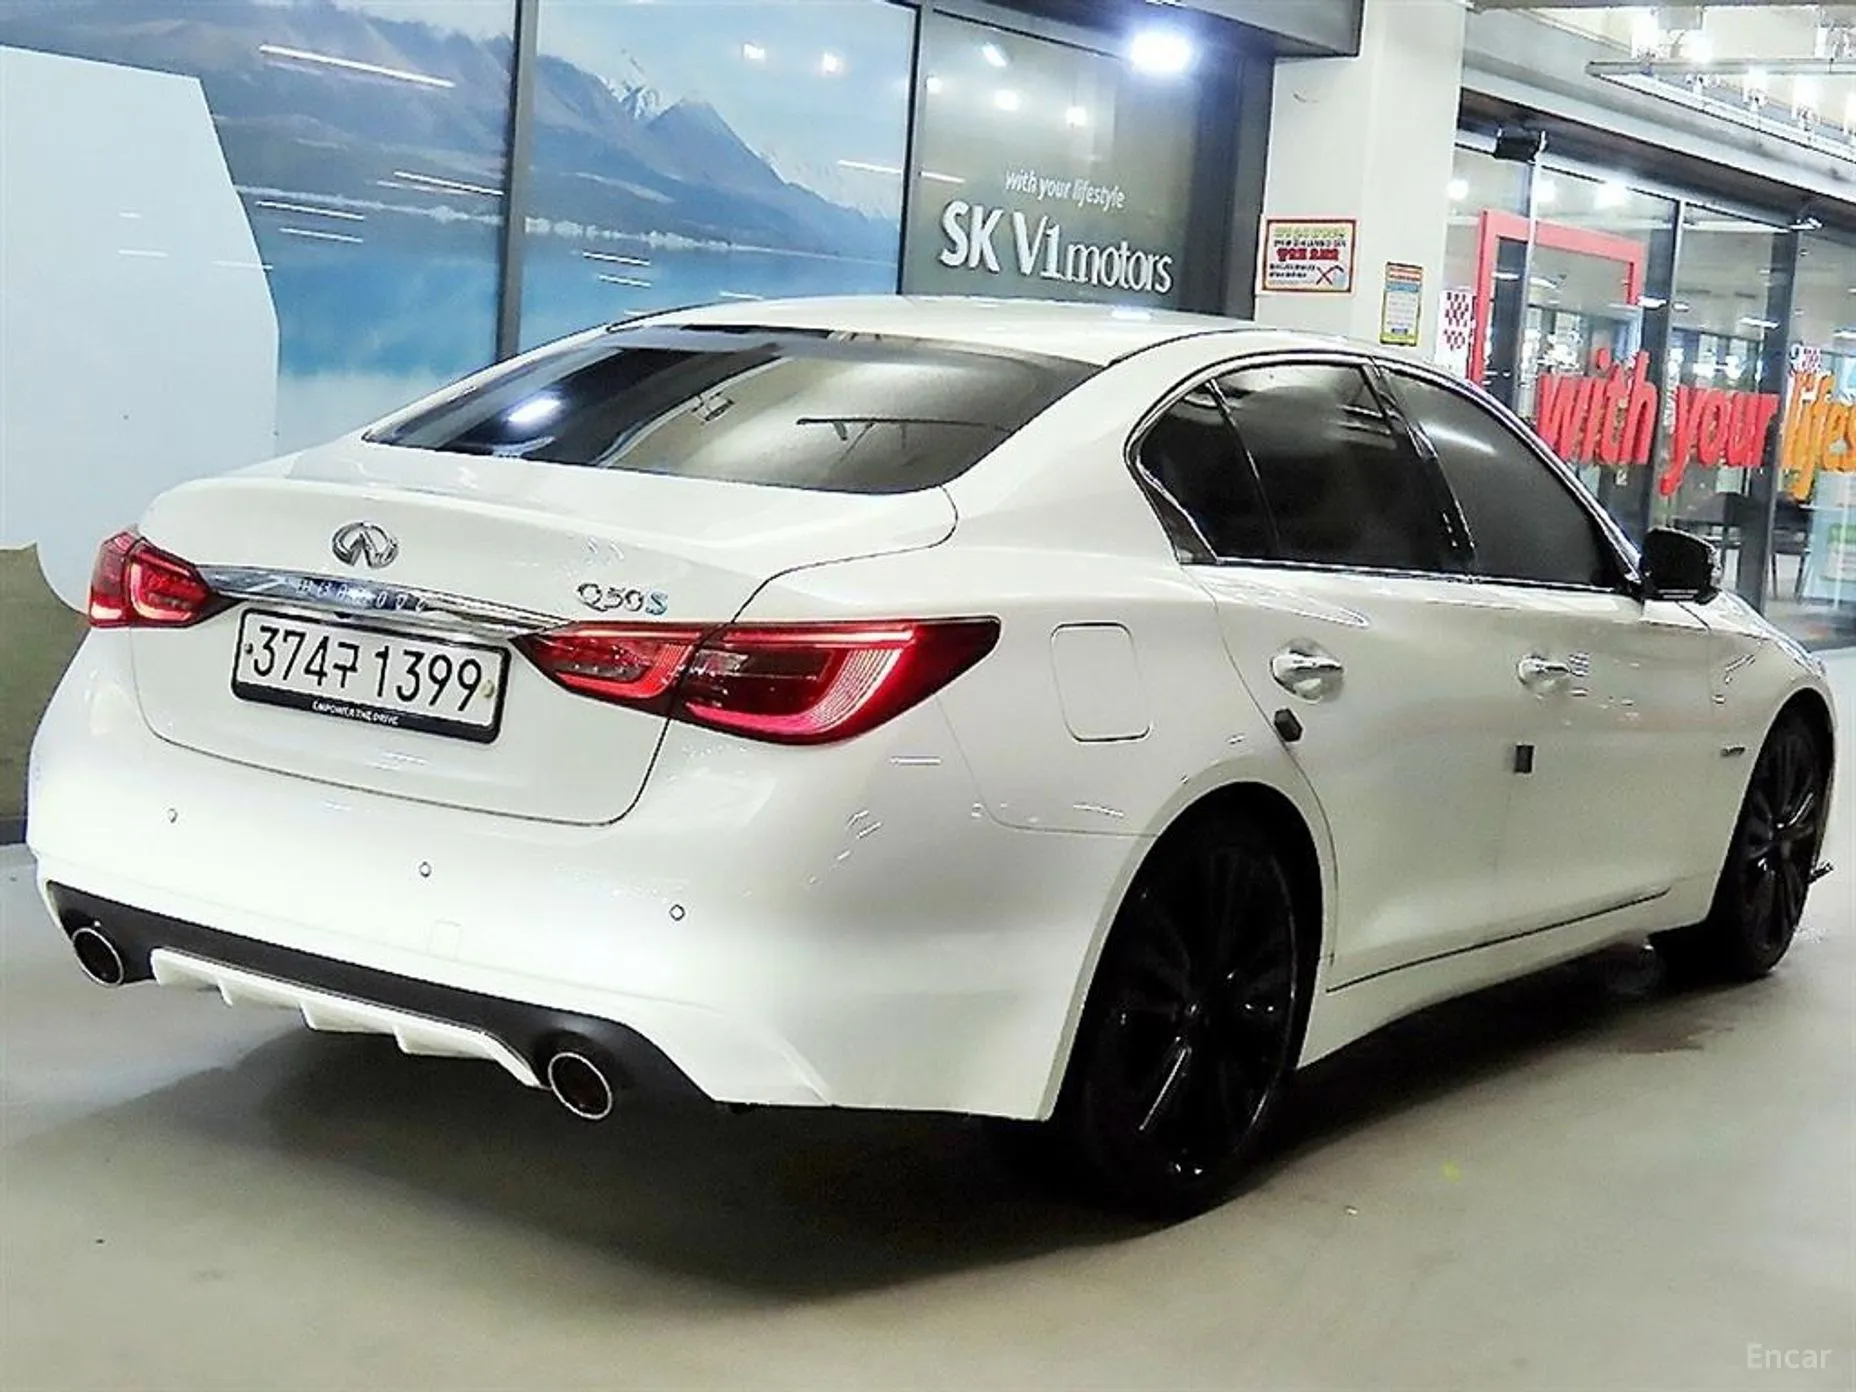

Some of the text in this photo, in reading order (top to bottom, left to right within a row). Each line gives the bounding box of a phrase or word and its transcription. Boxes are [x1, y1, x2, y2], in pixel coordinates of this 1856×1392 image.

[1006, 168, 1125, 212] with your lifestyle
[940, 200, 1003, 275] SK
[1536, 347, 1658, 465] with
[1660, 384, 1781, 496] your
[253, 624, 482, 713] 374구 1399
